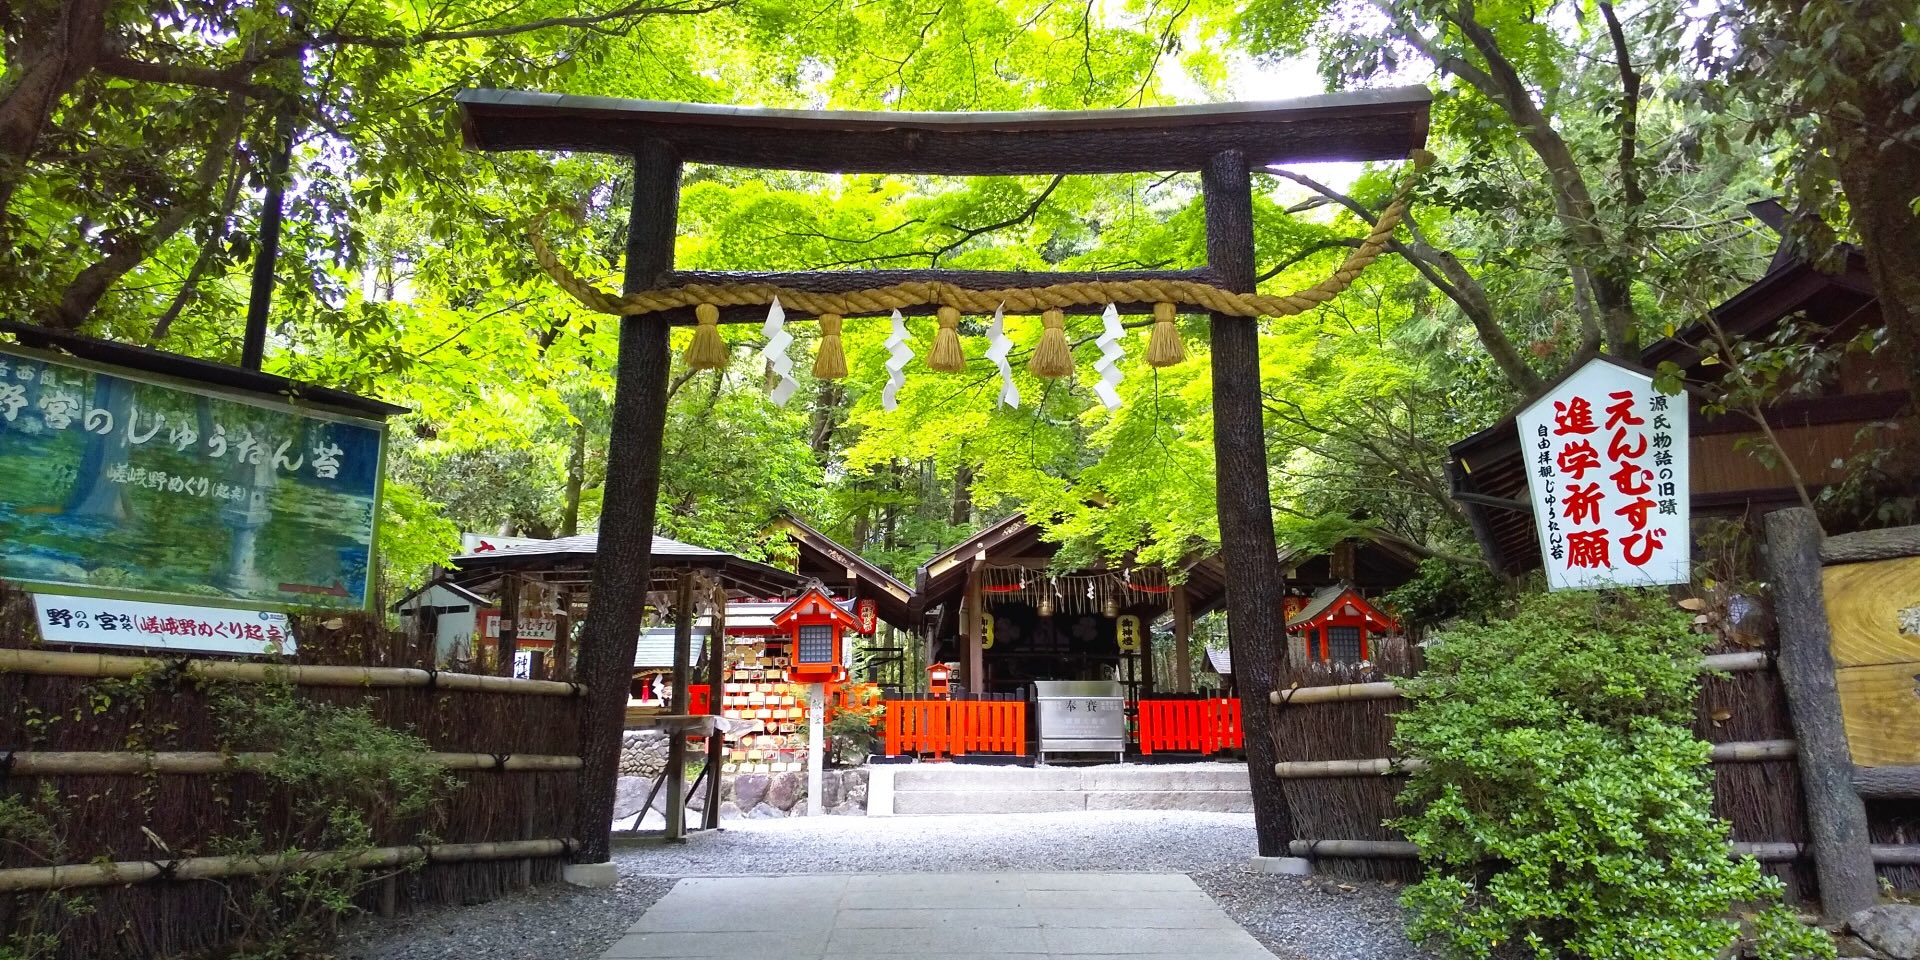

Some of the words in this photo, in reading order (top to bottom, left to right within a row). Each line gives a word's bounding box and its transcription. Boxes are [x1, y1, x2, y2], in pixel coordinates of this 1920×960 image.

[1553, 396, 1611, 570] 進学祈願
[1605, 390, 1667, 567] えんむすび
[1650, 396, 1678, 515] 源氏物語の旧蹟
